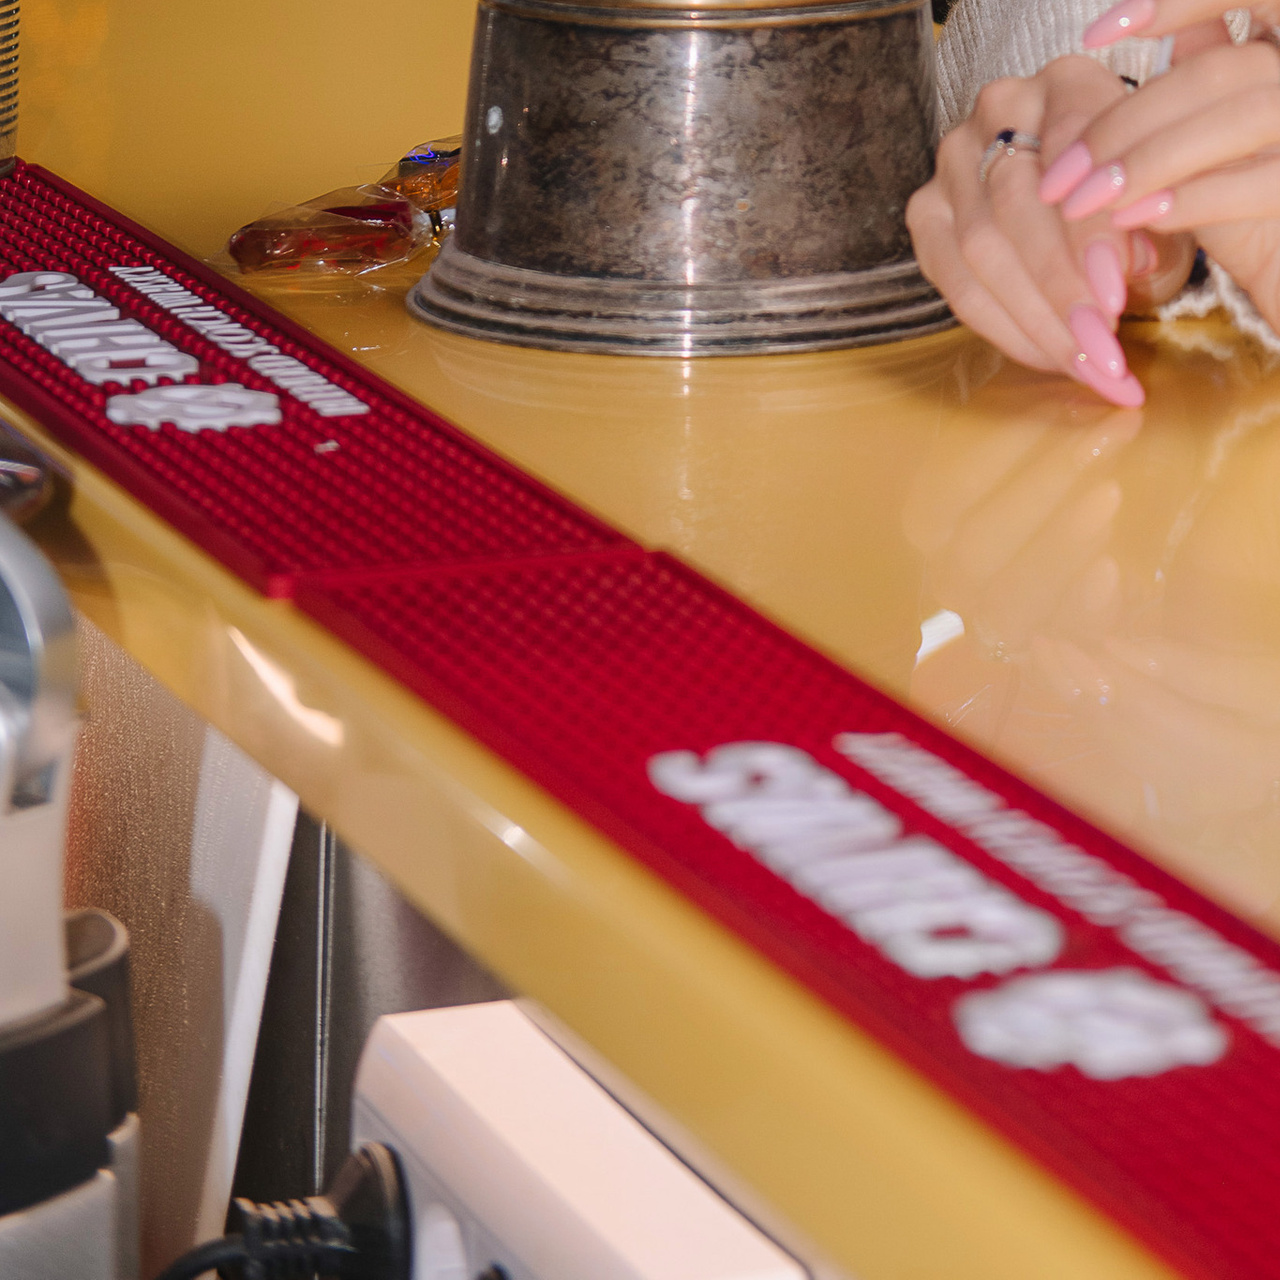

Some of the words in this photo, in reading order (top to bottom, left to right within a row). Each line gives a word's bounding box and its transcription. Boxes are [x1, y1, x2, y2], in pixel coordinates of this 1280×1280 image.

[108, 266, 204, 309] WHISKY
[0, 270, 199, 386] CHIVAS
[169, 305, 281, 358] SCOTCH
